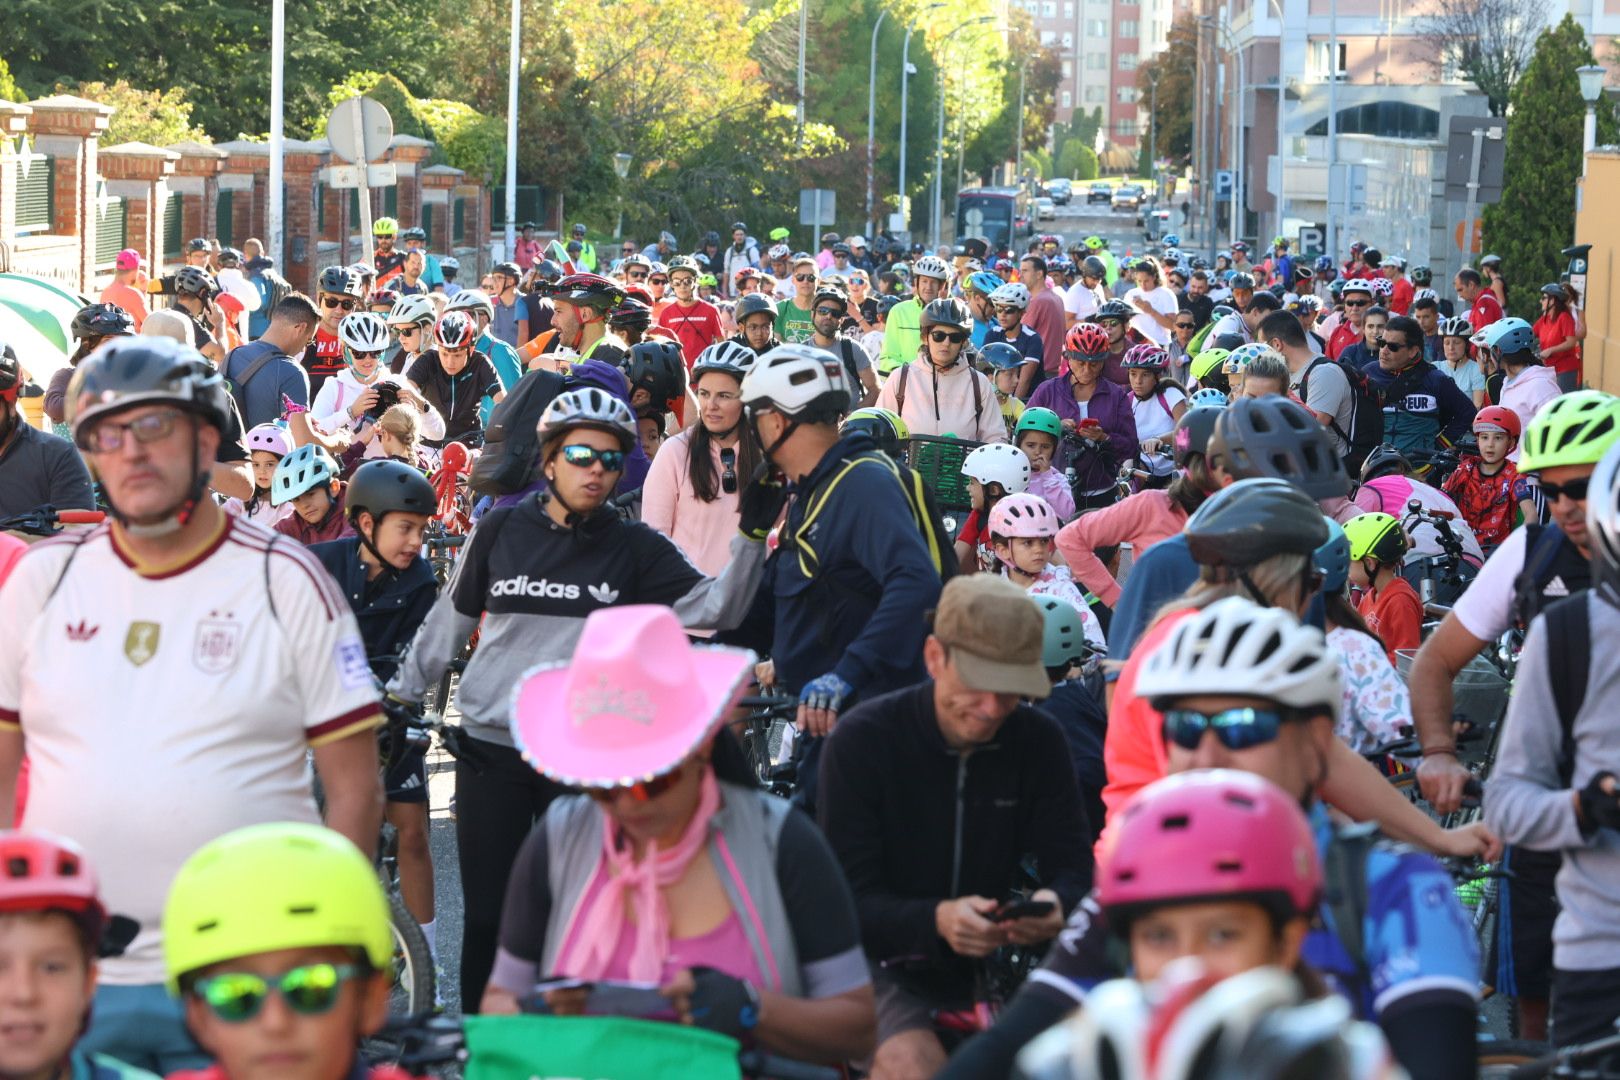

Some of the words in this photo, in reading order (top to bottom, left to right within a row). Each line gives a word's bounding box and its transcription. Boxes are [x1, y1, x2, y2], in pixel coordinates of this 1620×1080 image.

[1216, 172, 1233, 193] P
[1575, 259, 1585, 272] P
[490, 575, 580, 600] adidas
